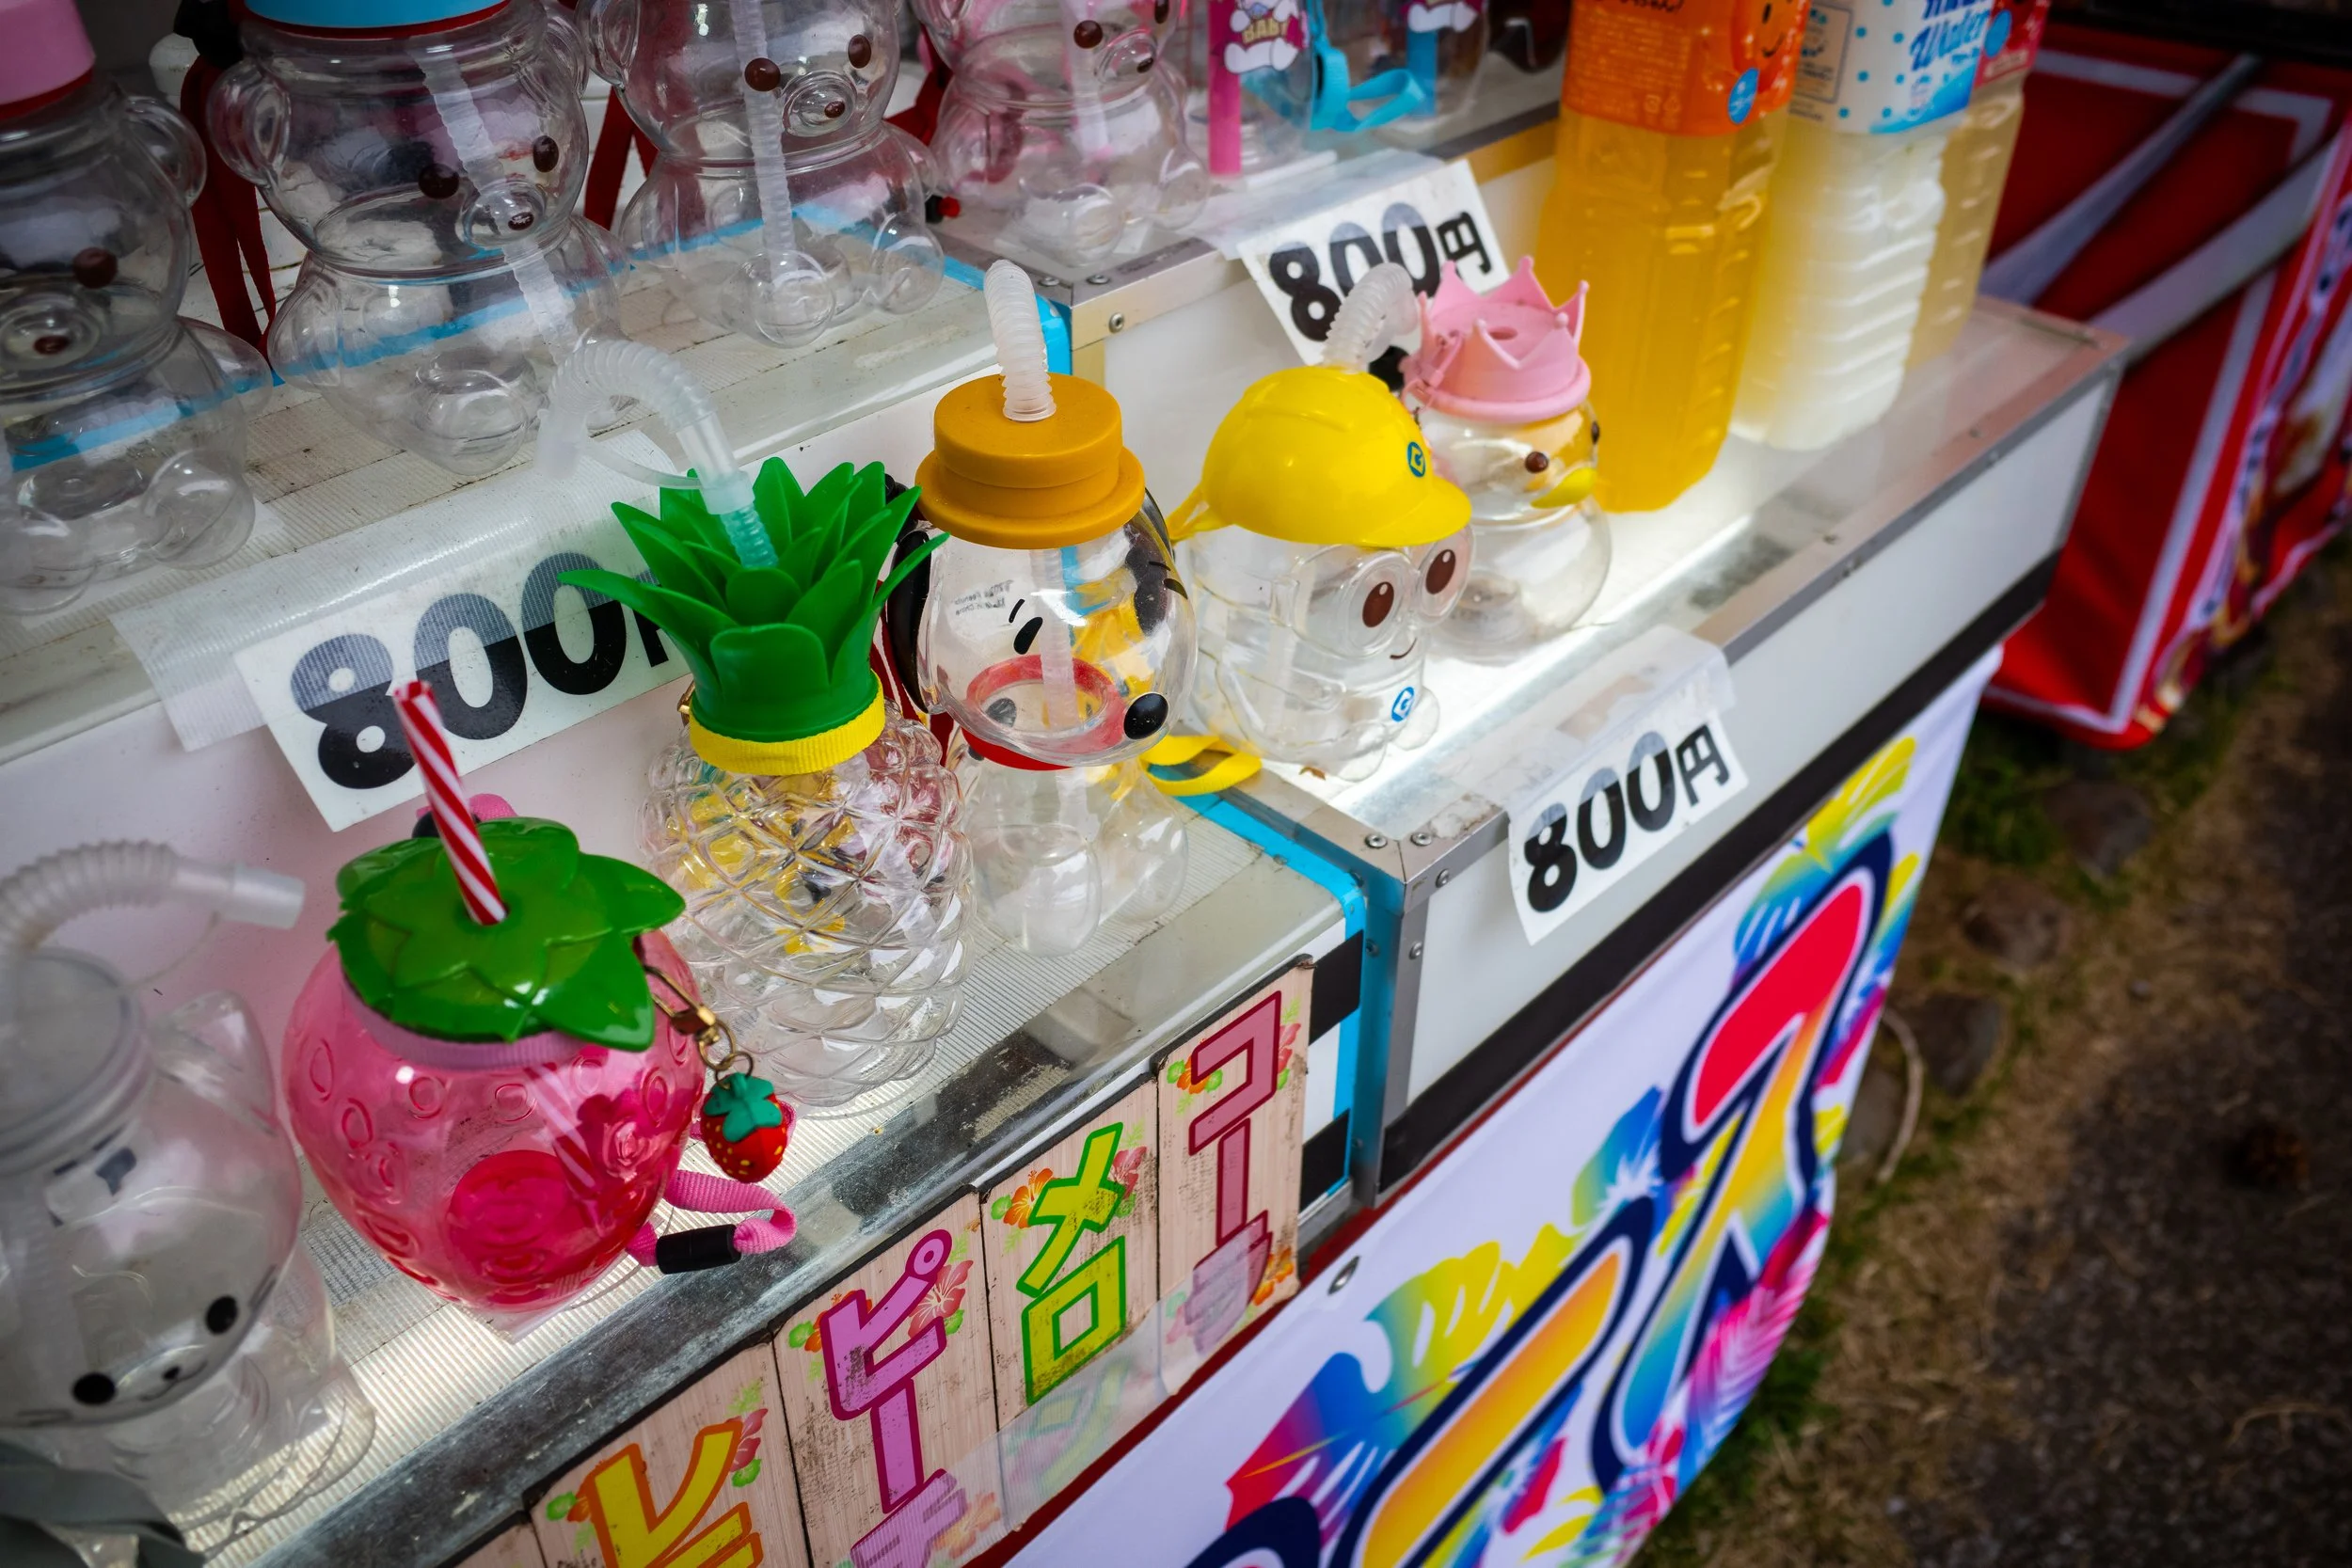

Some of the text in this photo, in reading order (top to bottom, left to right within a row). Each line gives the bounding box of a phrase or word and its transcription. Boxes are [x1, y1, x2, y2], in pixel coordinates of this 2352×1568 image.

[1268, 201, 1492, 341] 800円
[290, 552, 670, 790] 800
[1523, 722, 1731, 914] 800円
